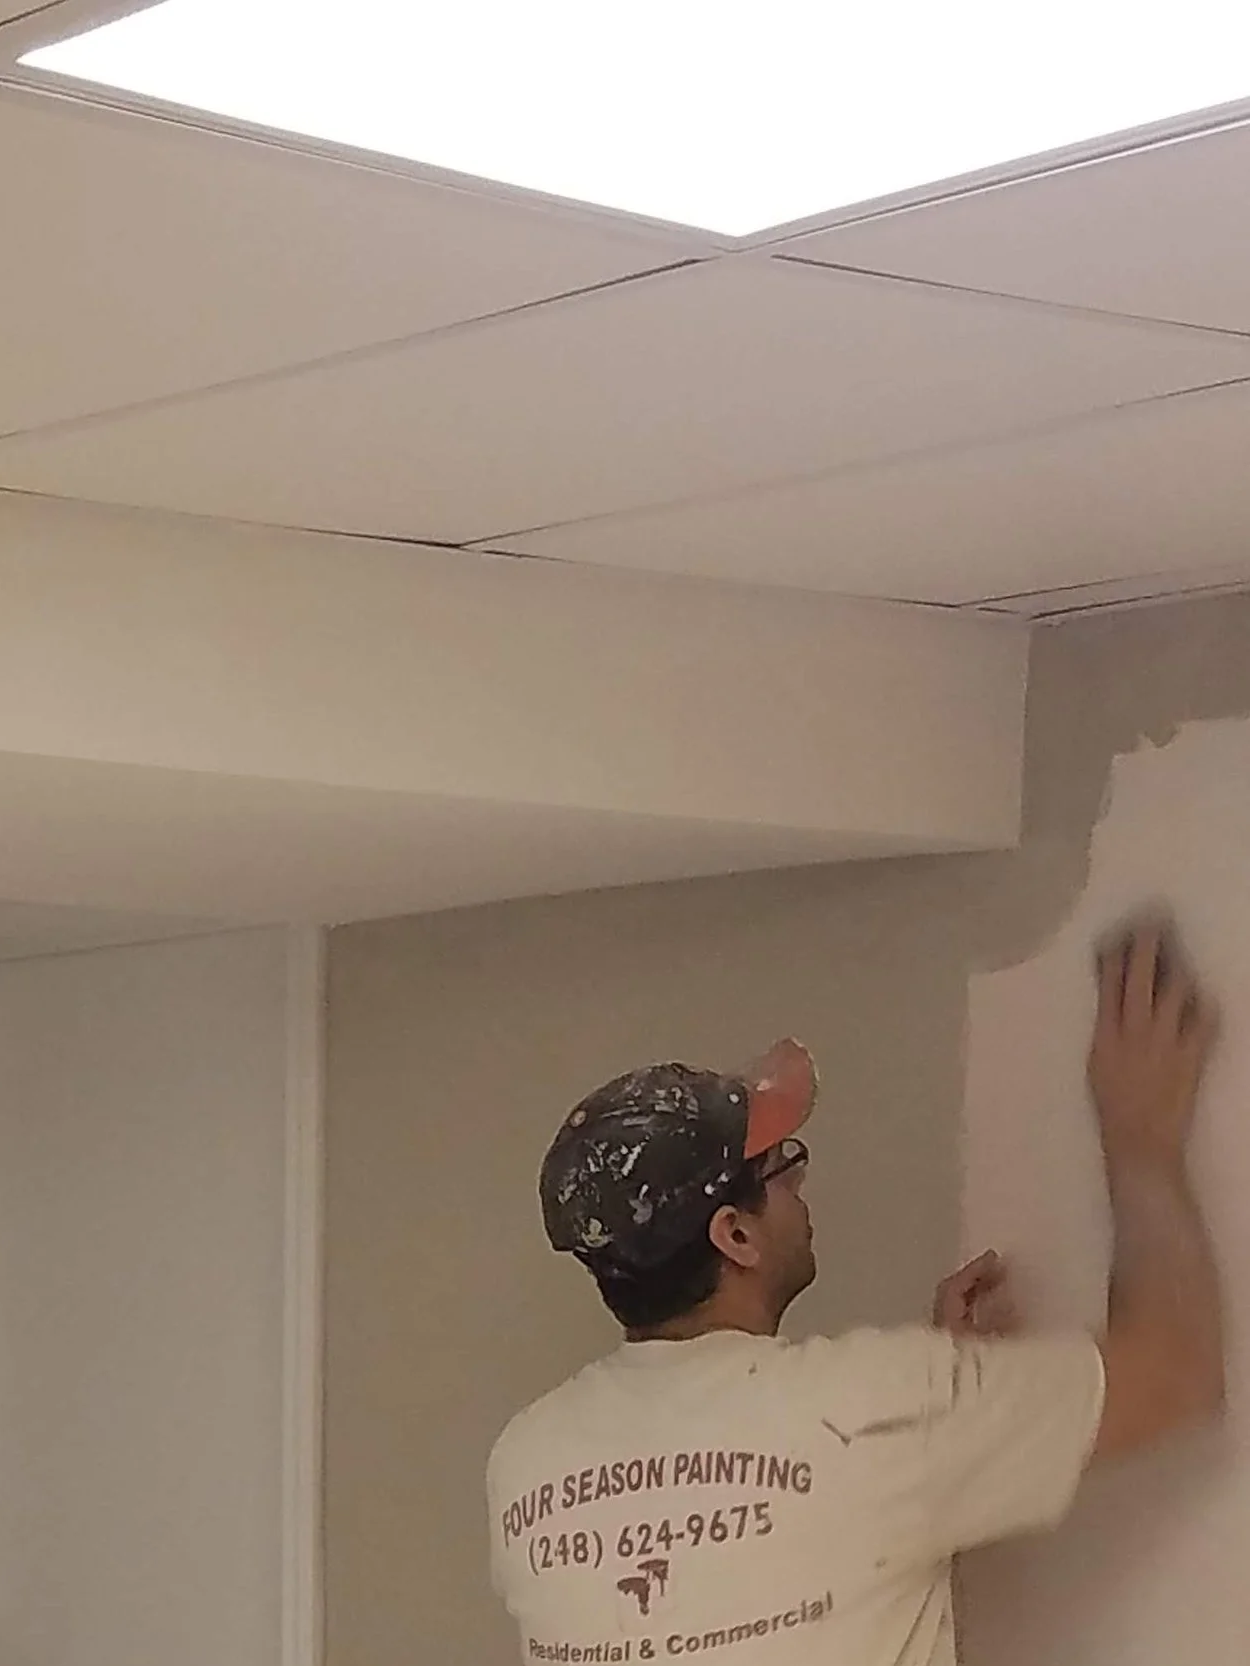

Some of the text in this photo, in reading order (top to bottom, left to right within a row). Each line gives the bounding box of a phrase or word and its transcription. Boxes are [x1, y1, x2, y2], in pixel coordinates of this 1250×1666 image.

[502, 1450, 813, 1547] FOUR SEASON PAINTING
[528, 1501, 774, 1576] (248) 624-9675
[528, 1591, 834, 1664] Residential & Commercial
